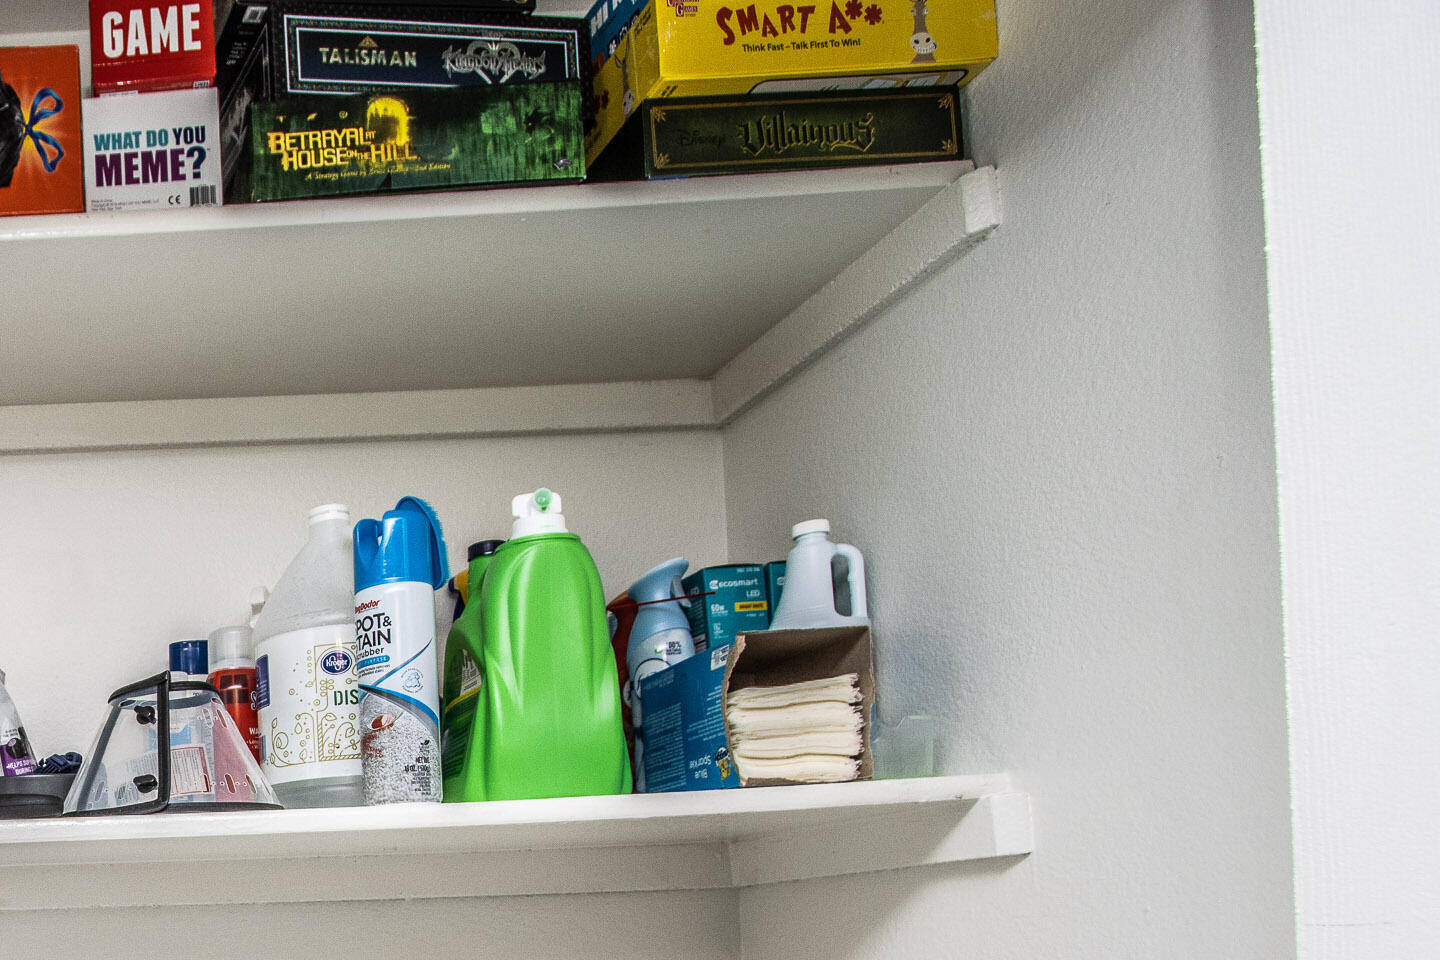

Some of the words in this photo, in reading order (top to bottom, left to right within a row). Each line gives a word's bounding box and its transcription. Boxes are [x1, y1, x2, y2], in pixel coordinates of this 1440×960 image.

[102, 4, 201, 59] GAME
[716, 4, 816, 46] SMART
[319, 47, 417, 67] TALISMAN
[742, 43, 765, 53] Think
[767, 43, 784, 52] Fast
[790, 41, 808, 50] Talk
[810, 40, 828, 49] First
[829, 39, 840, 48] To
[841, 38, 860, 47] Win!
[93, 131, 142, 151] WHAT
[146, 128, 169, 147] DO
[172, 125, 206, 145] YOU
[267, 127, 371, 154] BETRAYAL
[95, 145, 207, 187] MEME?
[281, 147, 348, 171] HOUSE
[718, 578, 759, 588] ecosmart
[326, 655, 348, 670] Kroger
[333, 689, 358, 706] DIS
